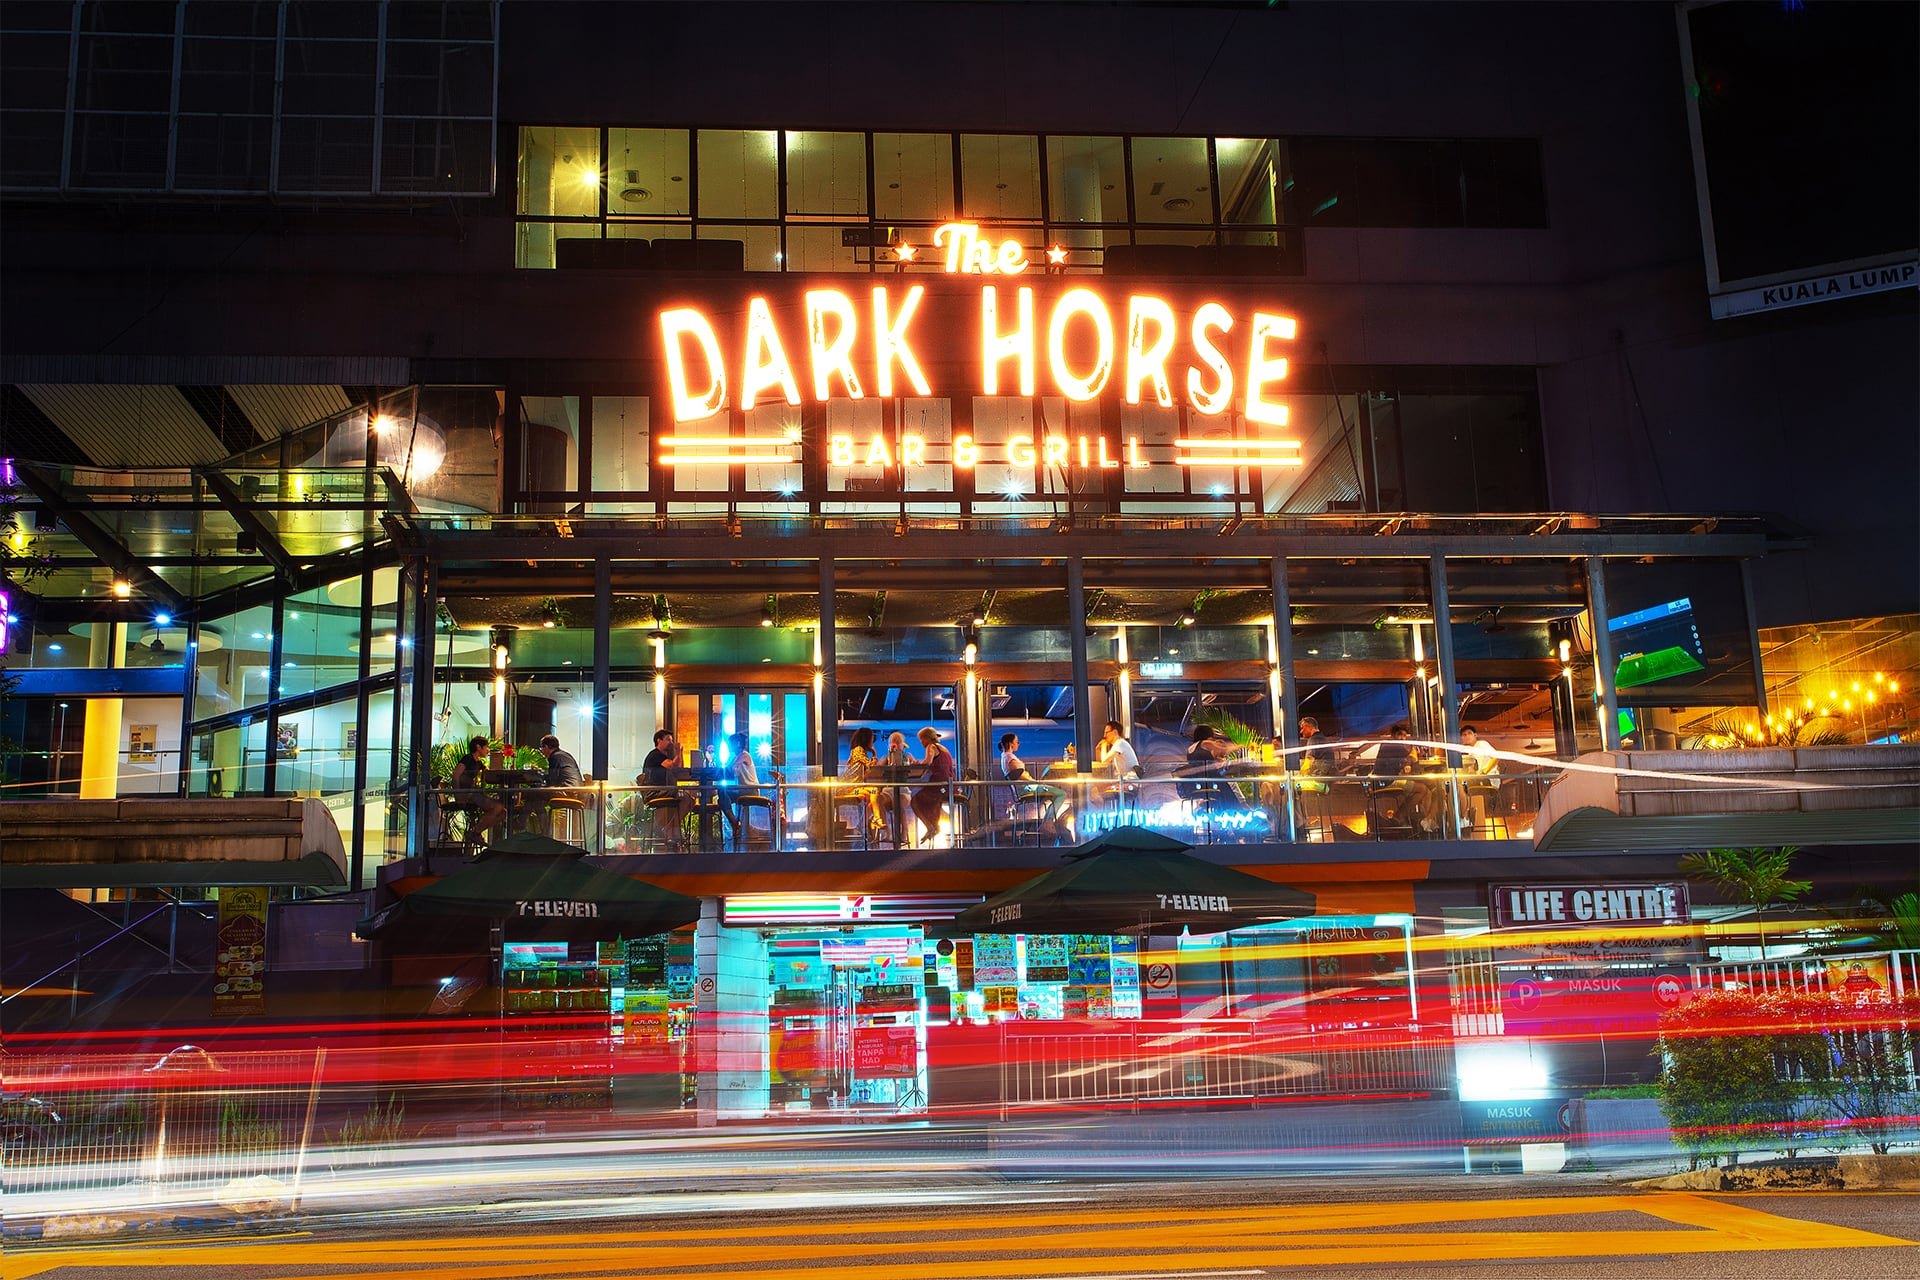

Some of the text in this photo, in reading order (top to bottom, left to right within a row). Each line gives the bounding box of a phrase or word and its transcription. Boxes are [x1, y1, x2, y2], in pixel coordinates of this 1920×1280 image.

[933, 223, 1030, 275] The
[1763, 261, 1920, 305] KUALA LUMP
[658, 285, 1298, 427] DARK HORSE
[830, 434, 1150, 469] BAR & GRILL
[1510, 889, 1677, 921] LIFE CENTRE
[1602, 948, 1652, 961] Entrance
[1568, 980, 1622, 992] MASUK
[857, 1048, 885, 1057] TANPA
[862, 1056, 881, 1065] HAD
[1487, 1107, 1532, 1118] MASUK
[1482, 1120, 1540, 1130] ENTRANCE
